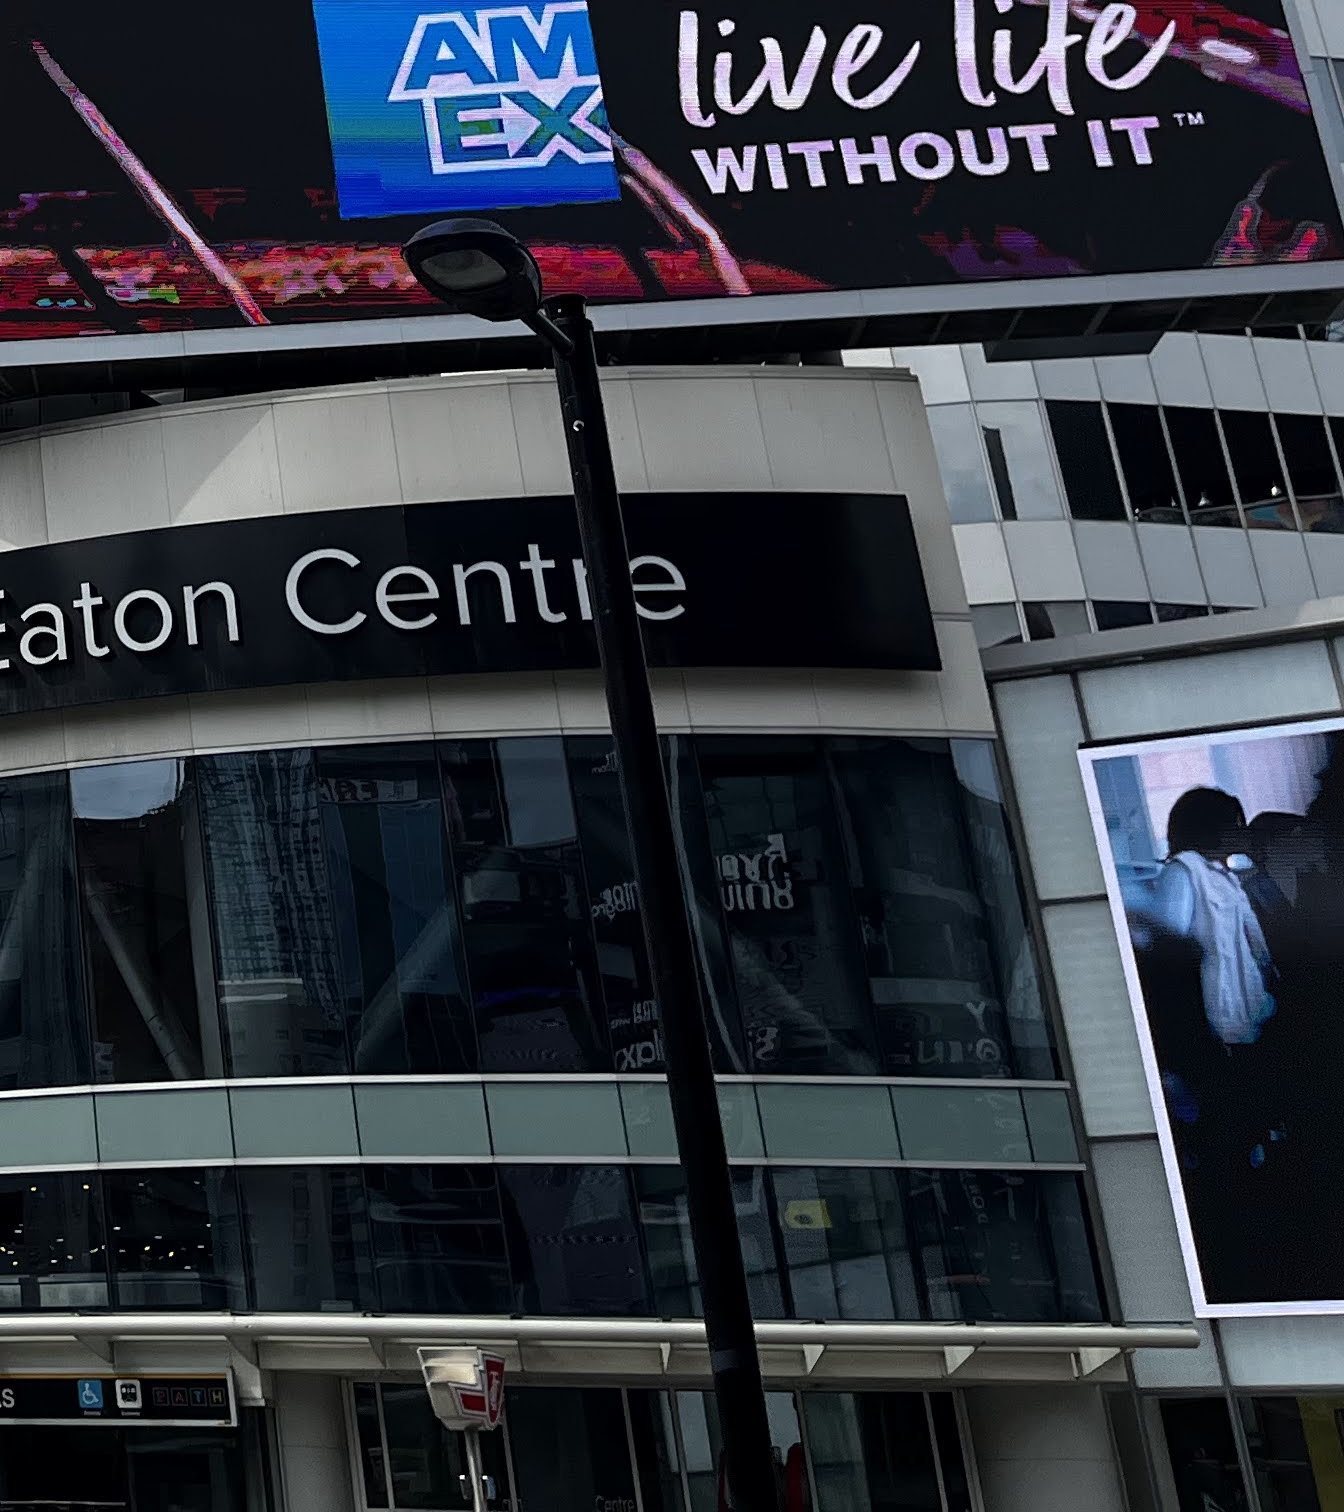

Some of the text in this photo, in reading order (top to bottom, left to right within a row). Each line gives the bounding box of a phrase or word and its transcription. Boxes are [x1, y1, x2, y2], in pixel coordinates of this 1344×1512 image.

[678, 10, 921, 128] live
[691, 123, 1058, 195] WITHOUT
[285, 543, 687, 635] Centre
